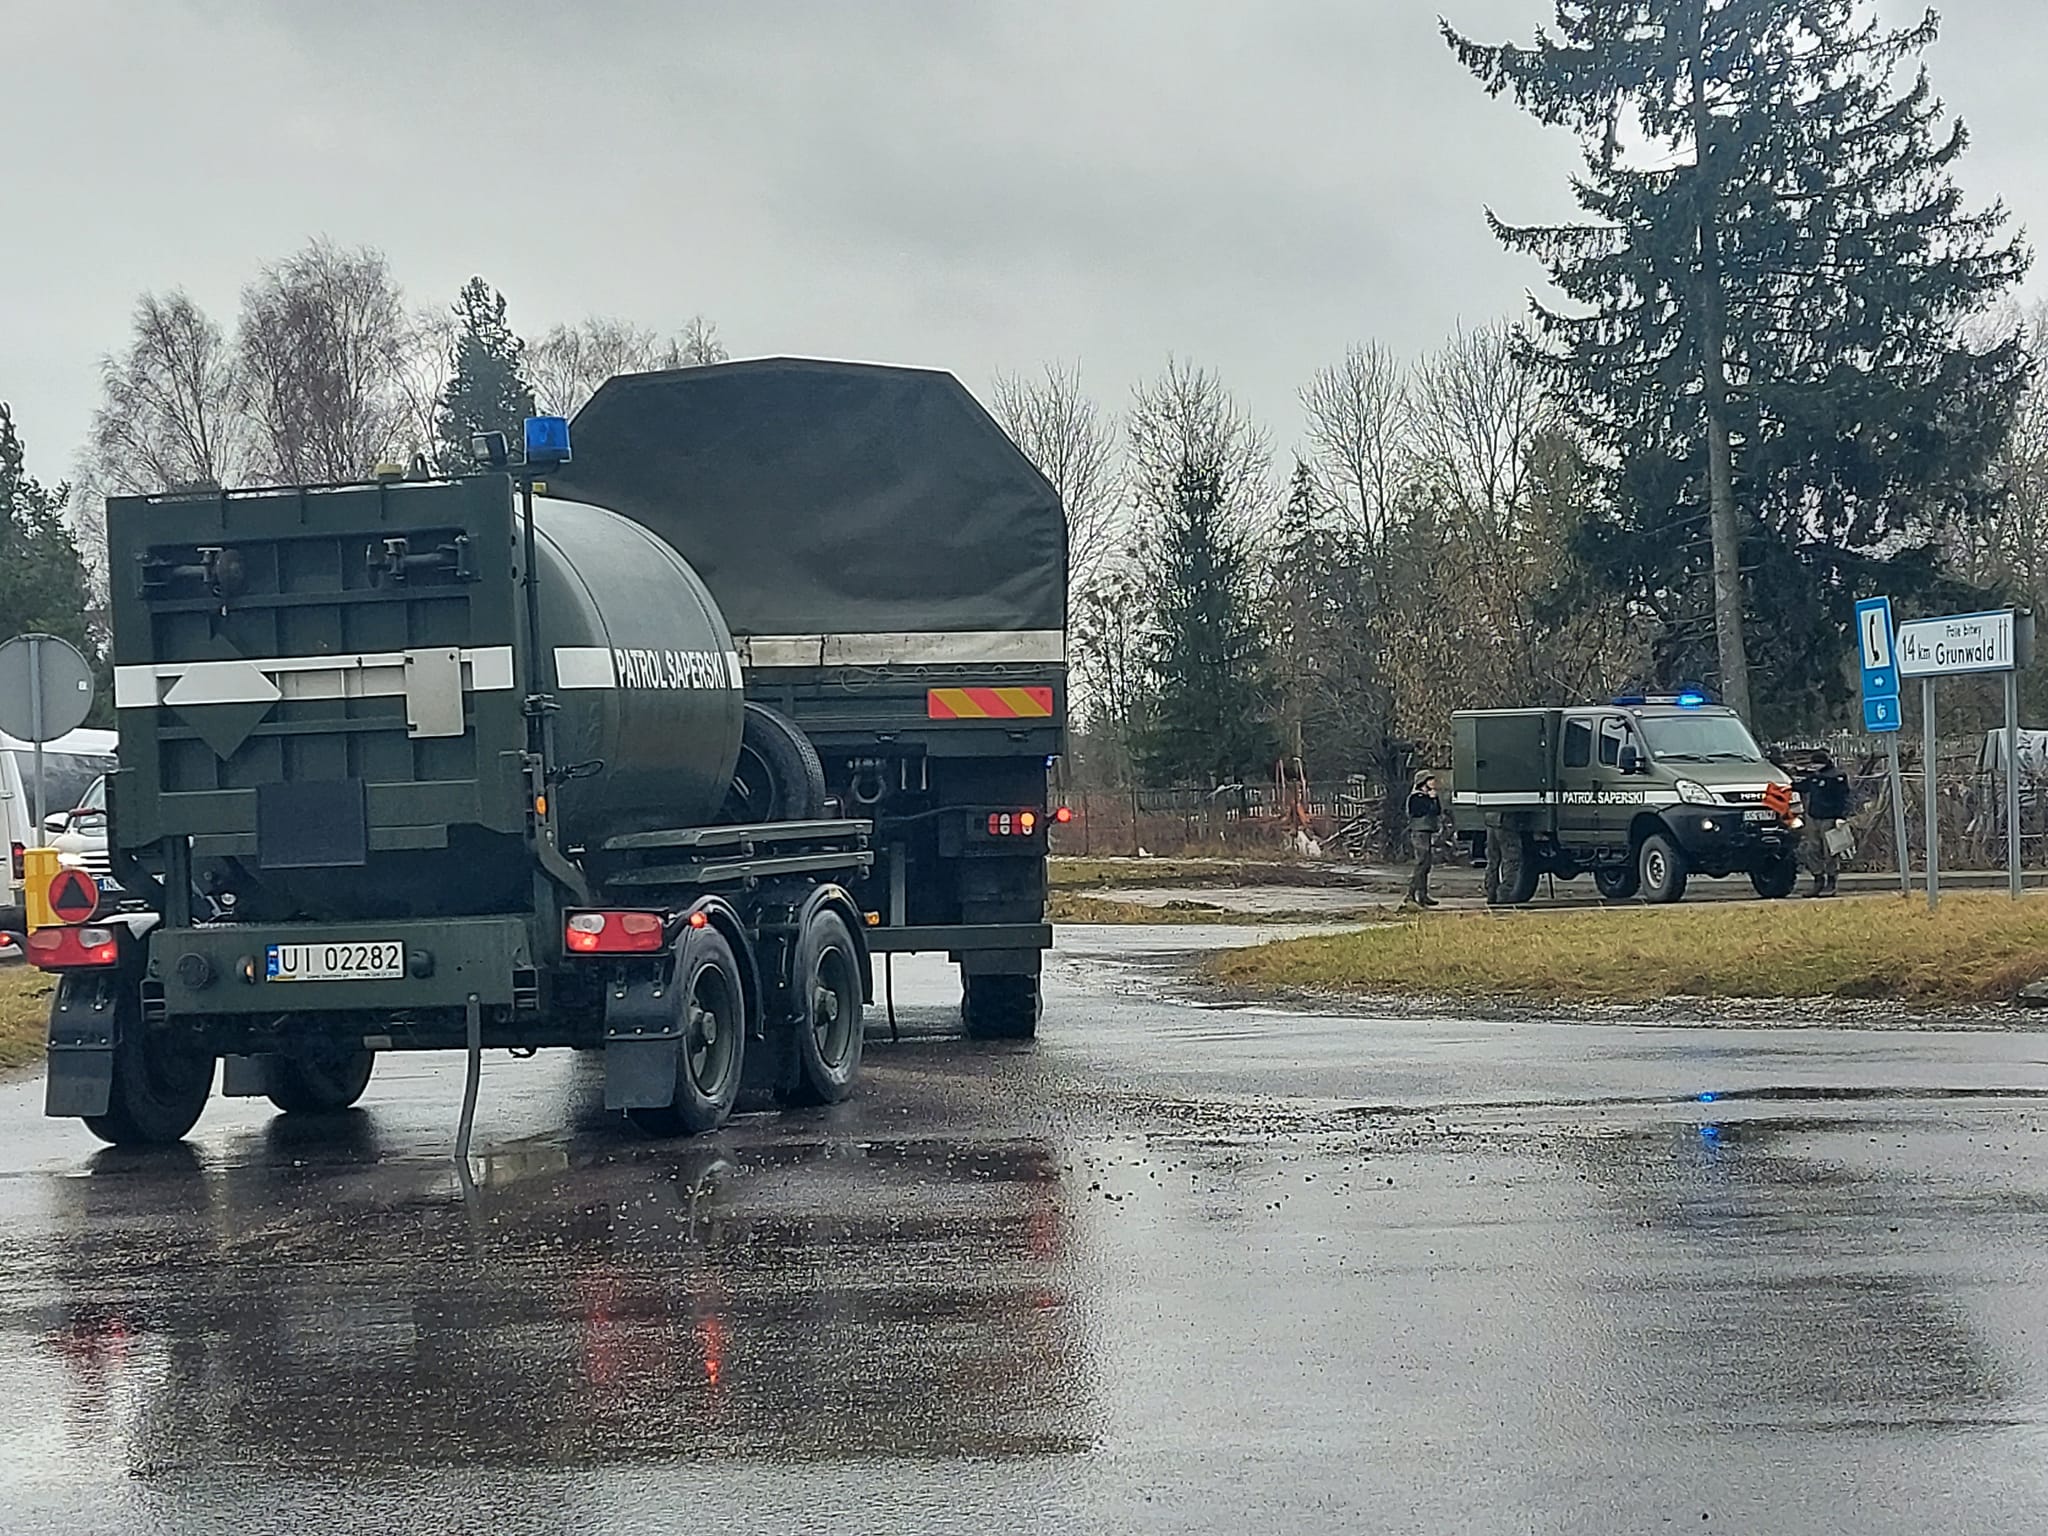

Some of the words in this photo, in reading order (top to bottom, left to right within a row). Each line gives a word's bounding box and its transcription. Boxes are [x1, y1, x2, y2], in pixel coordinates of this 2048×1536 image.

[1902, 633, 1917, 662] 14
[1918, 643, 1931, 660] km
[1935, 637, 1994, 665] Grunwald
[614, 648, 668, 689] PATROL
[665, 649, 728, 690] SAPERSKI
[1562, 791, 1597, 804] PATROL
[1598, 791, 1644, 804] SAPERSKI
[282, 947, 310, 973] UI
[325, 945, 399, 972] 02282
